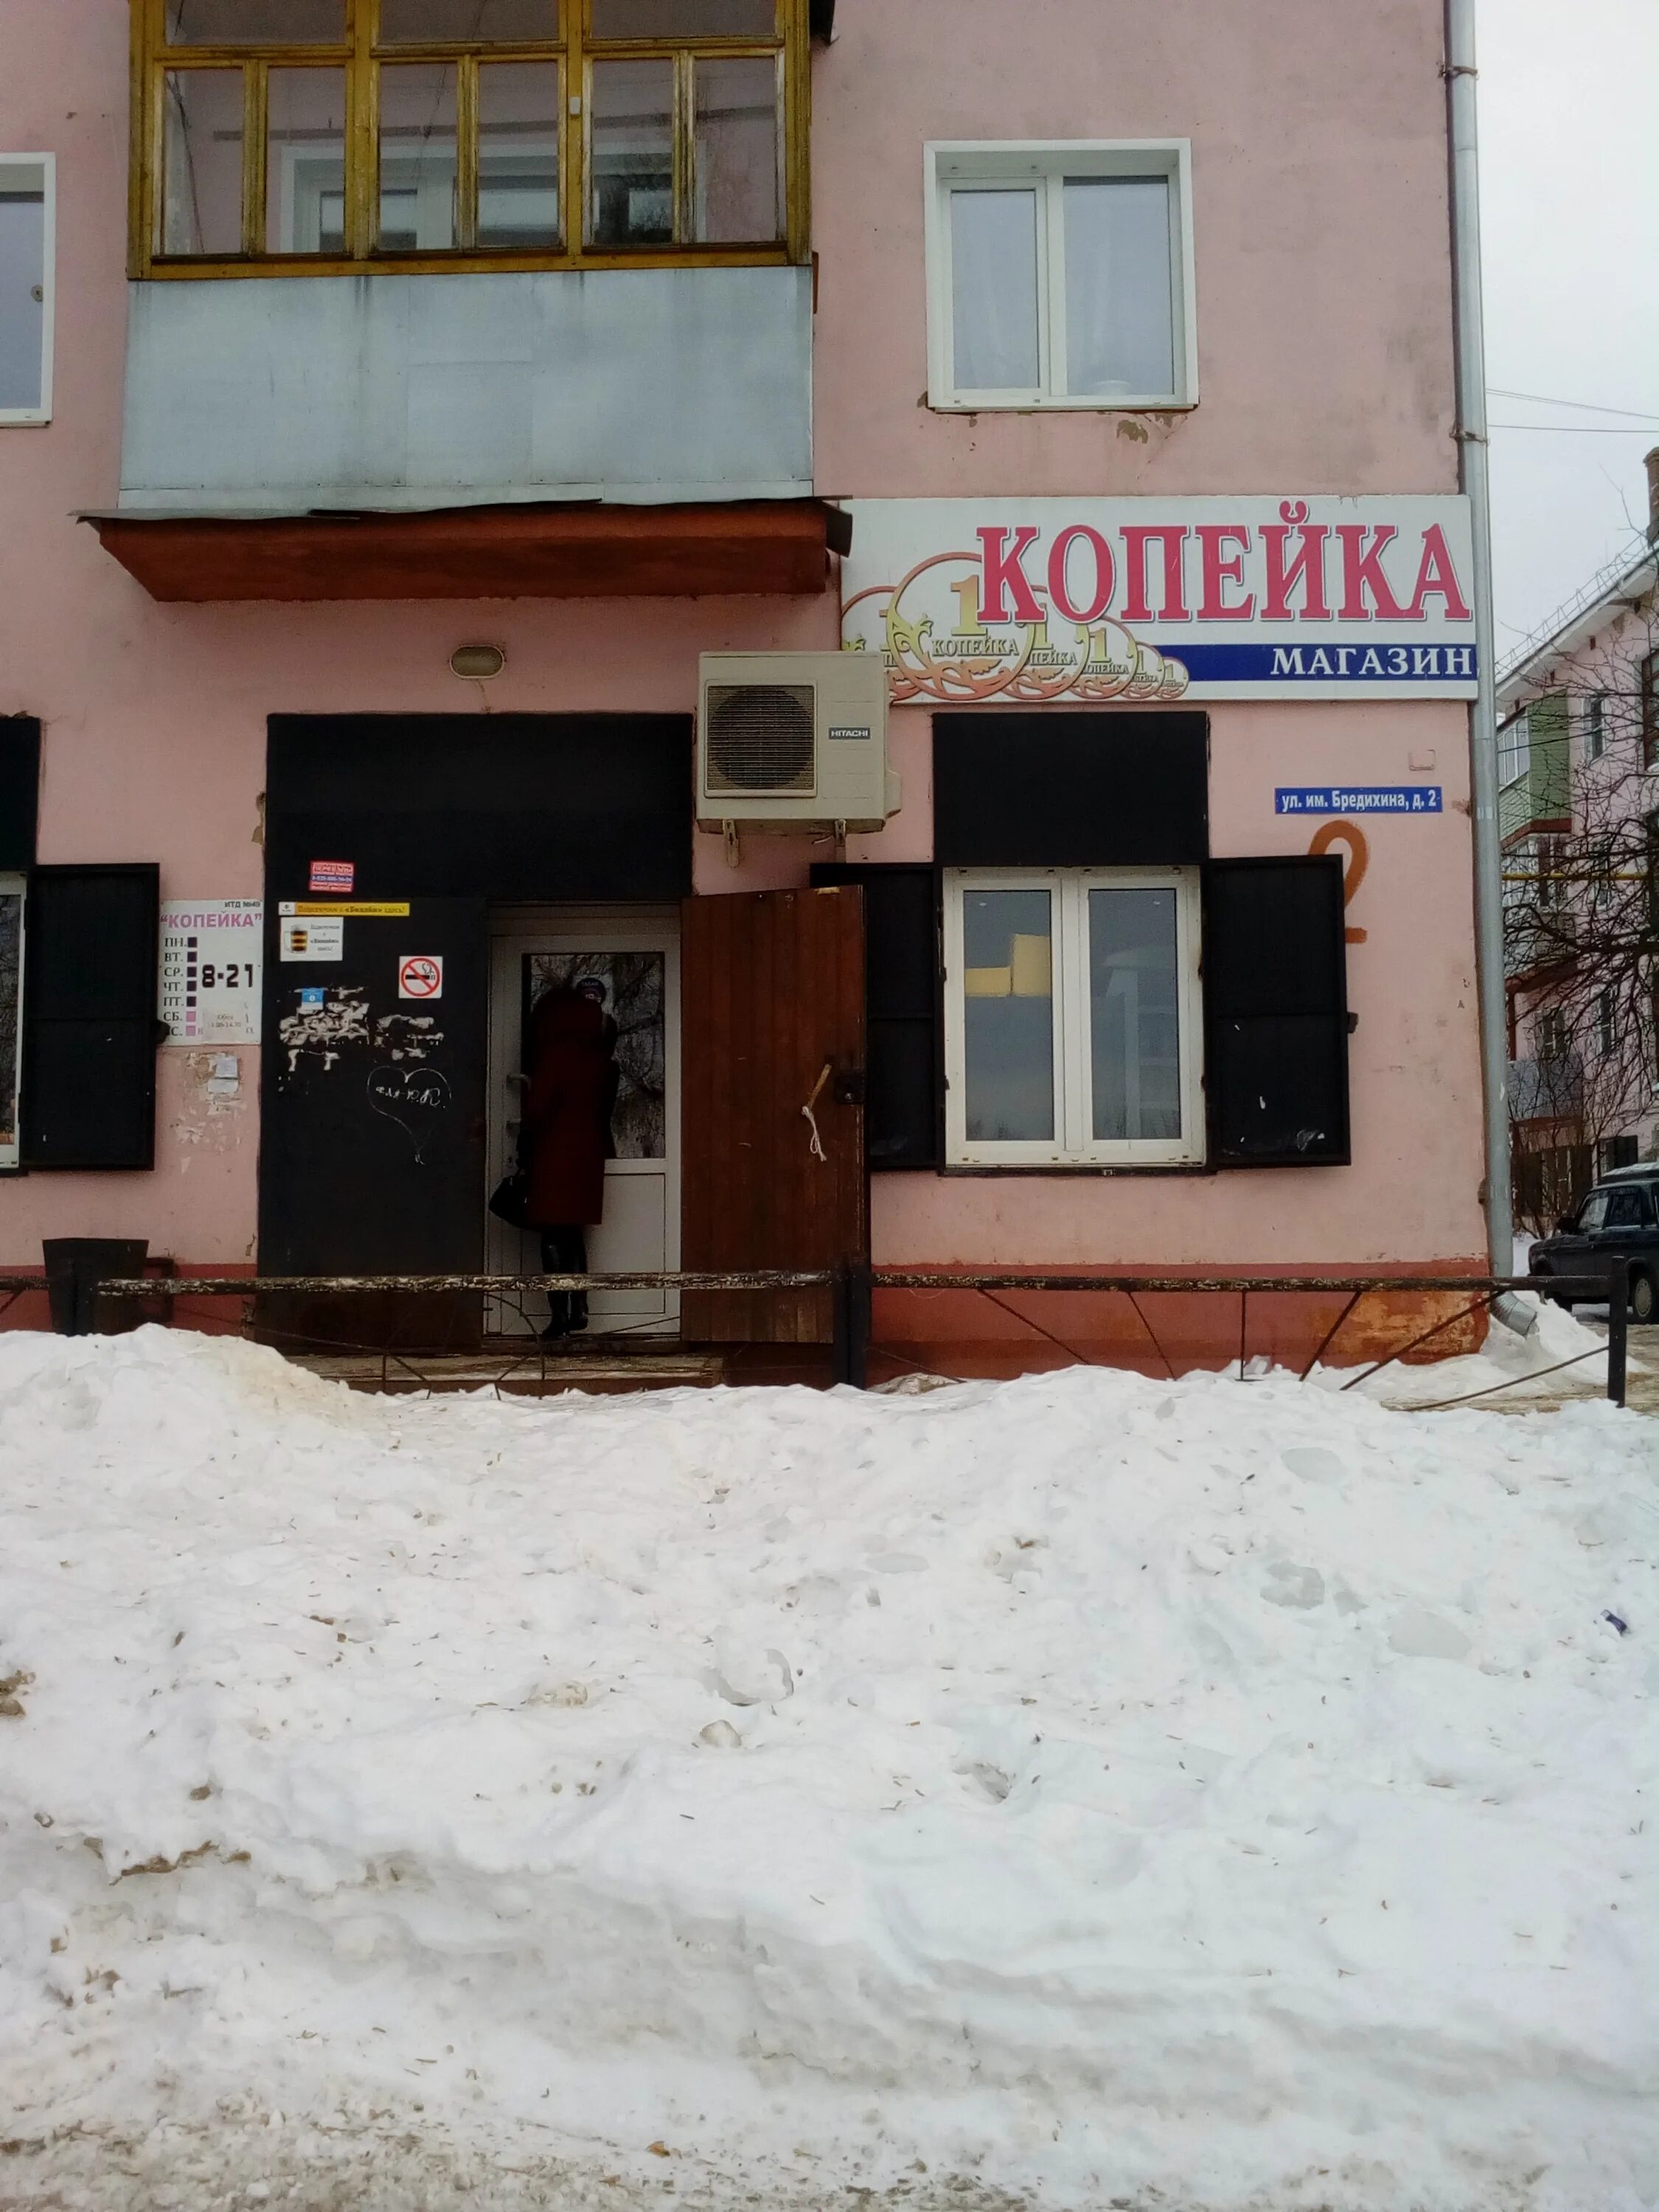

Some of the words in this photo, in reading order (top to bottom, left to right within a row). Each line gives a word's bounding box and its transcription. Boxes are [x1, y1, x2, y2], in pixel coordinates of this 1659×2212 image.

[977, 501, 1471, 621] КОПЕЙКА
[951, 575, 987, 636] 1
[932, 636, 1019, 656] КОПЕЙКА
[1270, 647, 1472, 675] МАГАЗИН
[1281, 795, 1302, 812] ул.
[1306, 796, 1328, 807] им.
[1332, 790, 1409, 810] Бредихина,
[1412, 793, 1425, 810] д.
[1428, 789, 1437, 807] 2
[164, 937, 187, 947] ПН.
[164, 953, 184, 962] ВТ.
[164, 967, 184, 977] СР.
[164, 981, 184, 992] ЧТ.
[164, 996, 184, 1006] ПТ.
[163, 1012, 183, 1021] СБ.
[170, 1026, 183, 1036] С.
